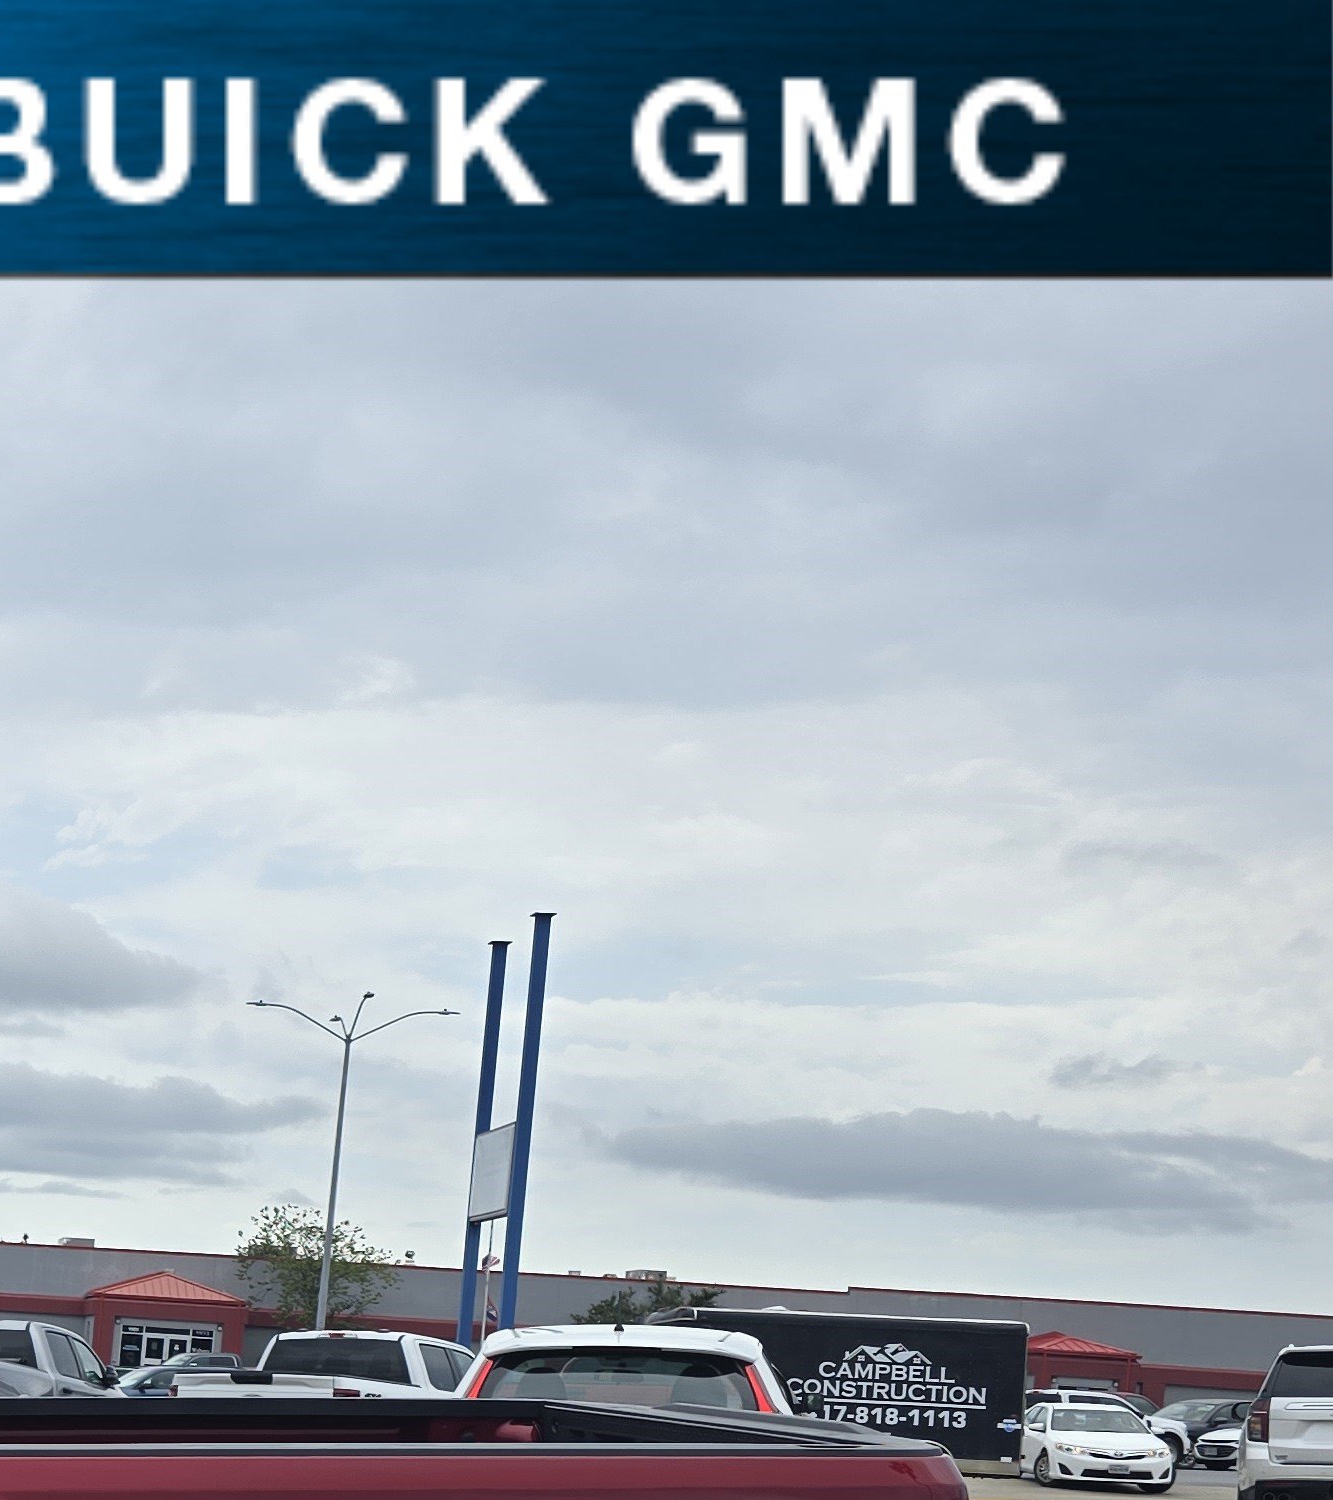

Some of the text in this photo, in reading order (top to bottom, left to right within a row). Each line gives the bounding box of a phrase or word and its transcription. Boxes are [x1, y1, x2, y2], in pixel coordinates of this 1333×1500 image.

[818, 1360, 956, 1384] CAMPBELL
[786, 1377, 987, 1404] CONSTRUCTION
[822, 1404, 967, 1429] 17-818-1113
